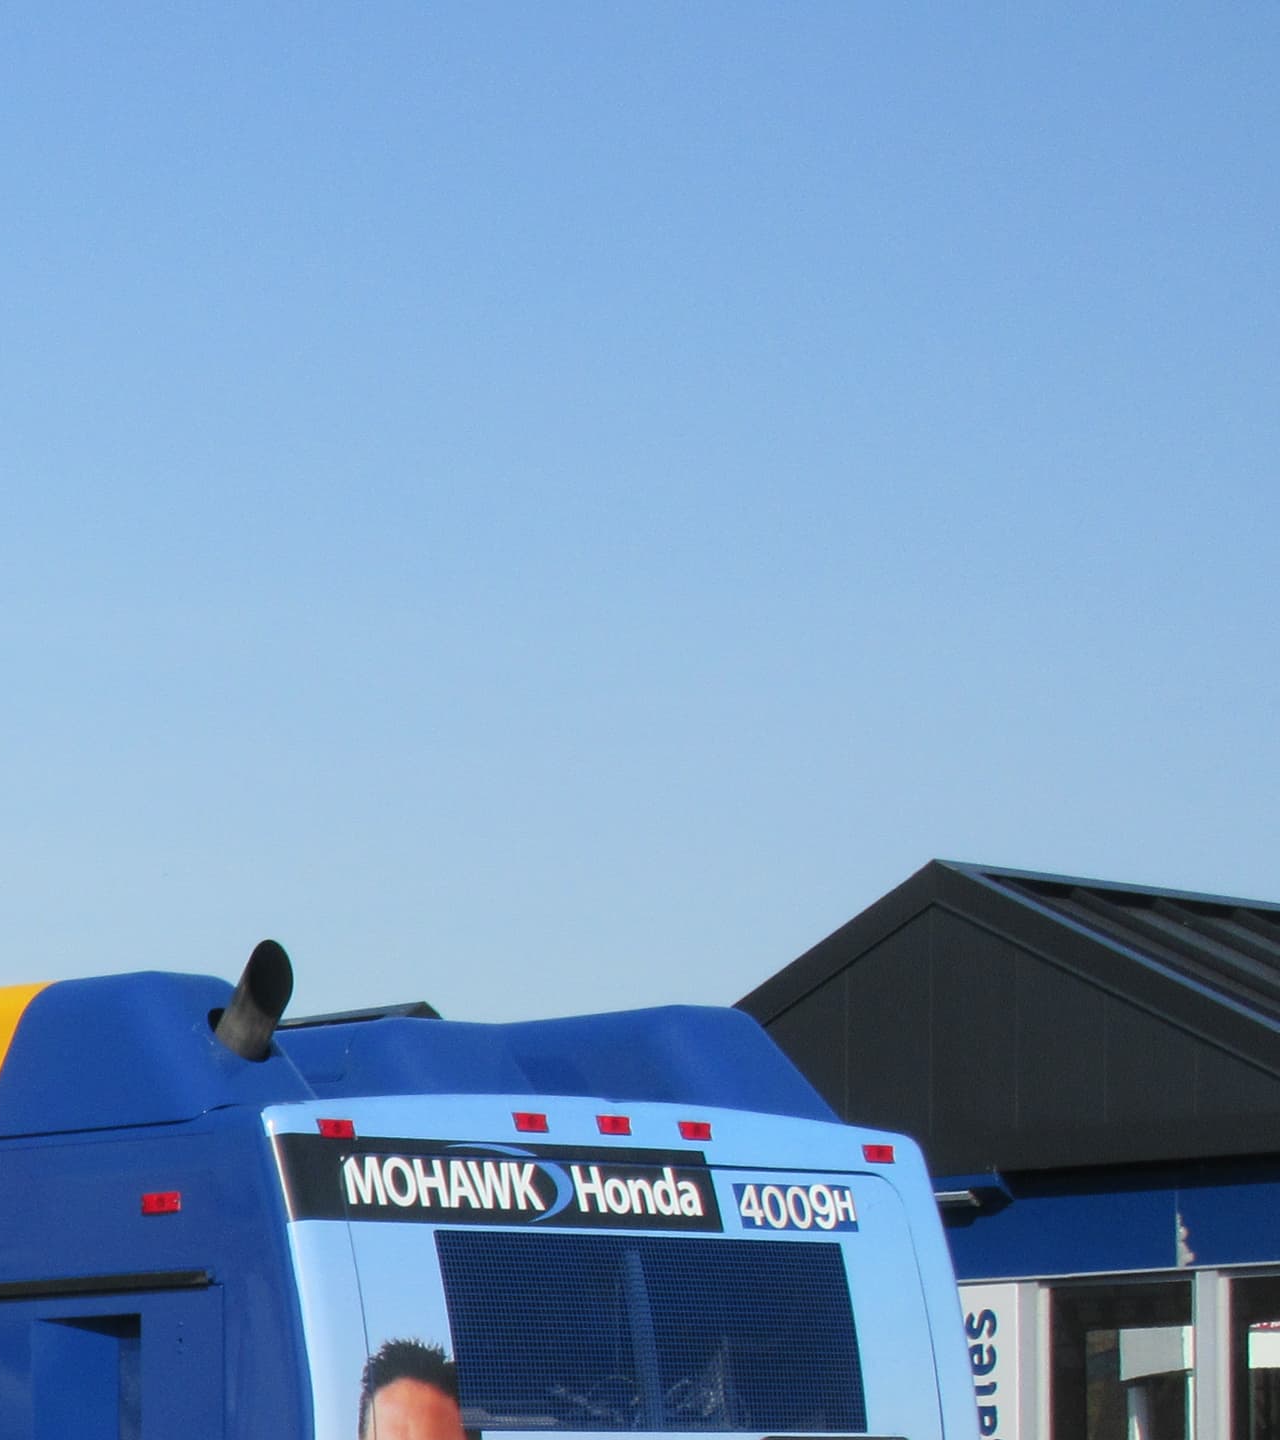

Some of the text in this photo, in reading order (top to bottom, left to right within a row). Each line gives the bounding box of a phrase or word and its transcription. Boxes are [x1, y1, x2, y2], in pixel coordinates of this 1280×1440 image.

[343, 1157, 704, 1217] MOHAWK Honda
[740, 1184, 856, 1230] 4009H
